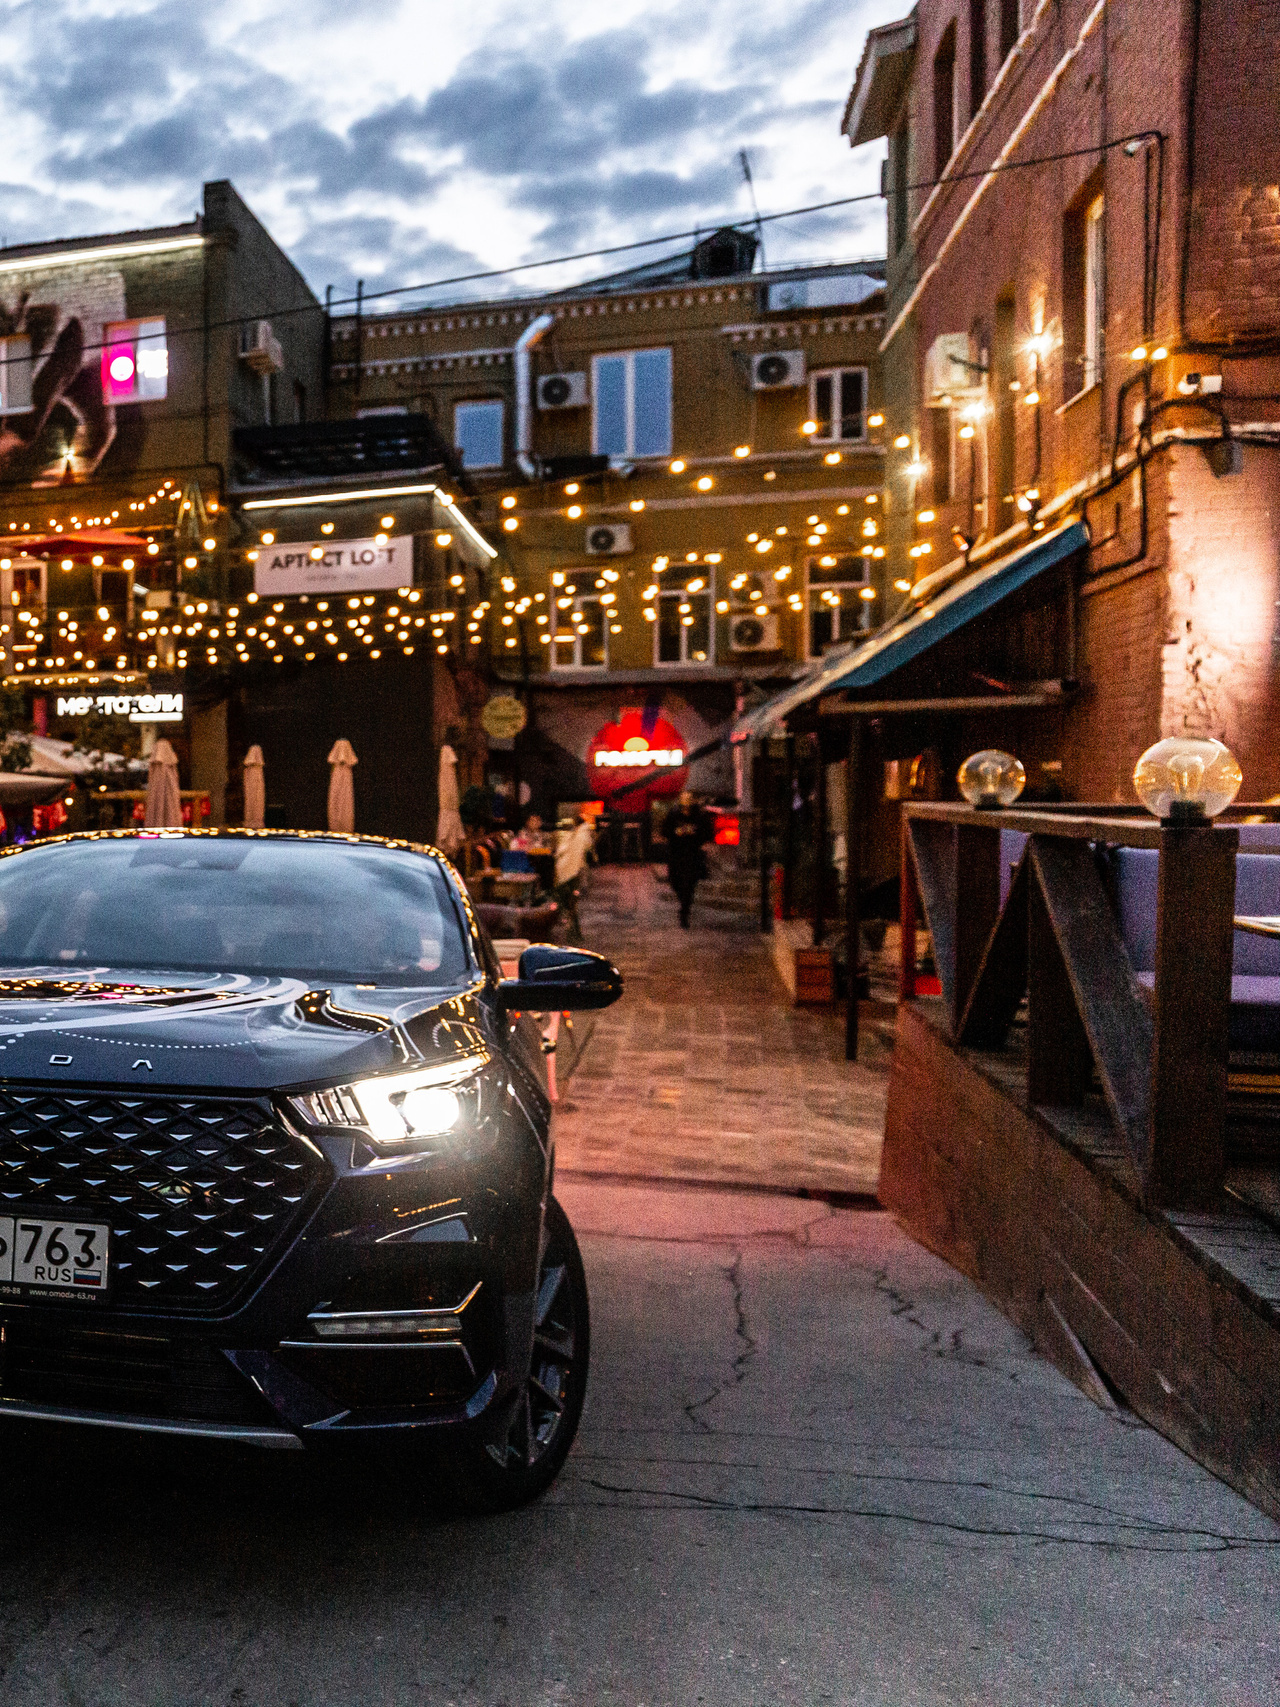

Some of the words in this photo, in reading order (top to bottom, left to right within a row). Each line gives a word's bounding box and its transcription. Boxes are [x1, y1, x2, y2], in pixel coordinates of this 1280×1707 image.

[20, 1224, 98, 1269] 763
[35, 1266, 71, 1282] RUS
[29, 1289, 96, 1301] www.omoda-63.ru
